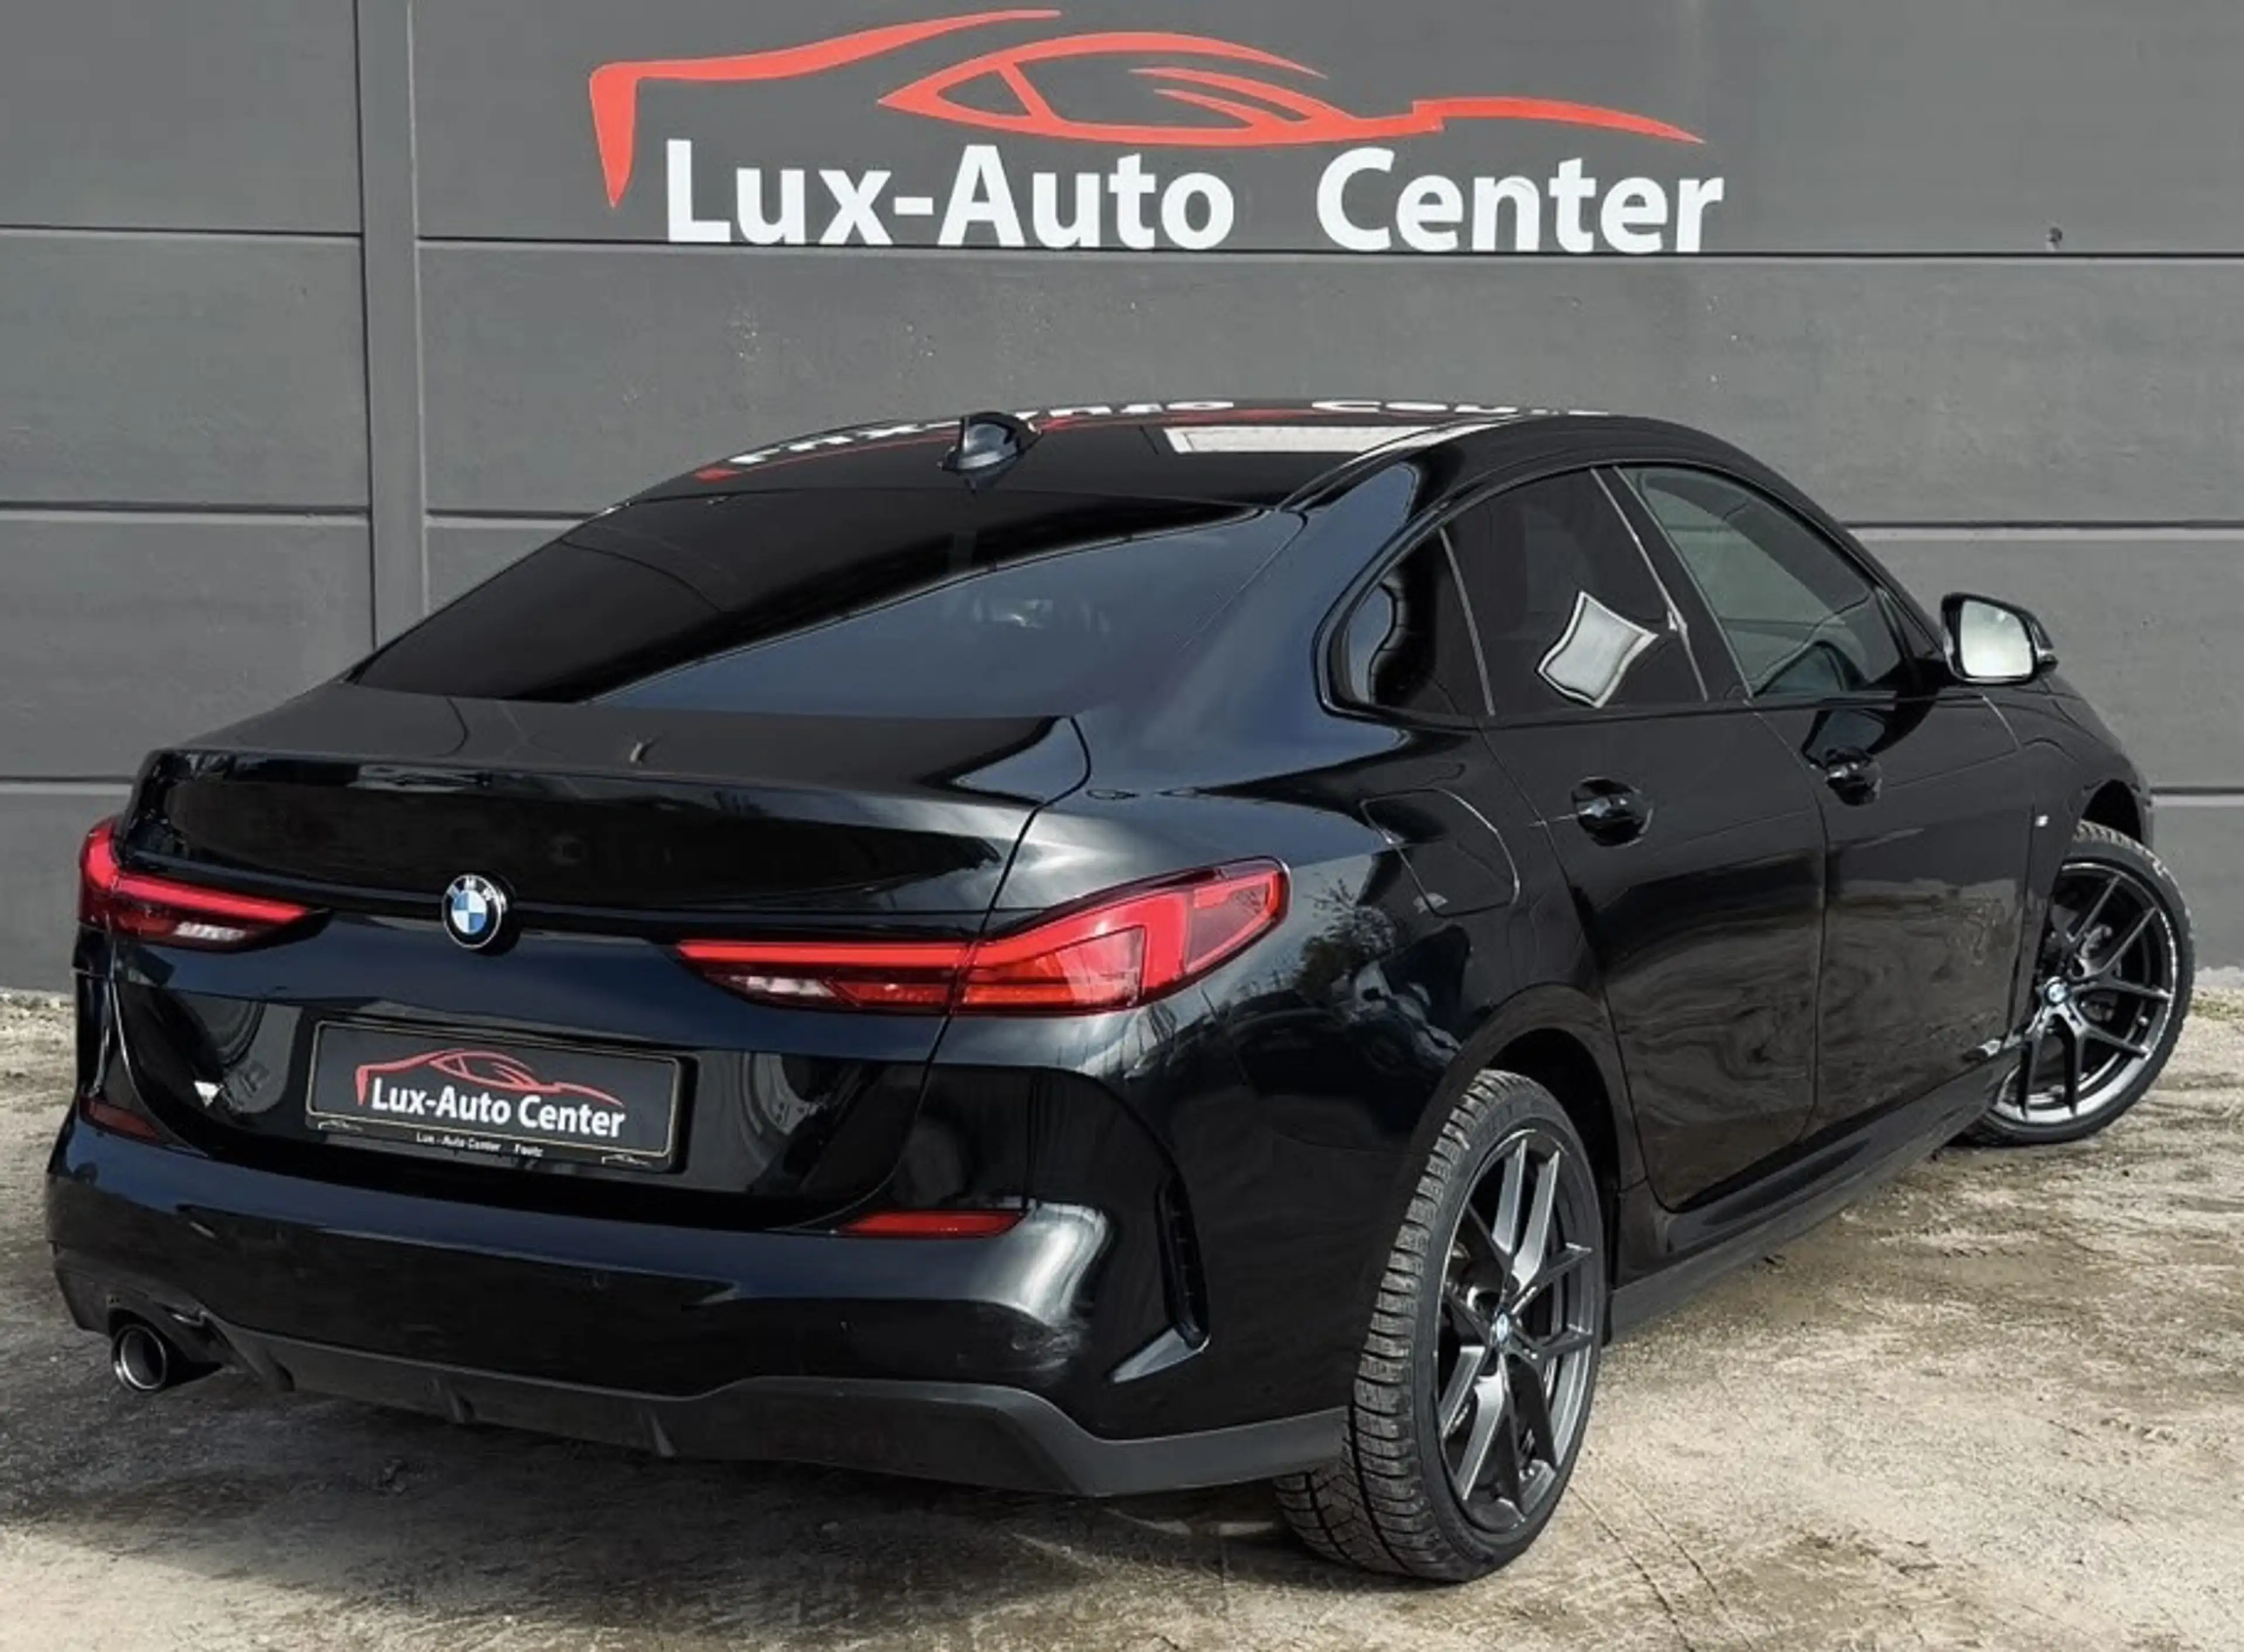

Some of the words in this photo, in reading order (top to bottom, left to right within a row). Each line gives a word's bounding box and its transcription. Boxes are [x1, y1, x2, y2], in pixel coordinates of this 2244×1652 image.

[666, 138, 1235, 250] Lux-Auto
[1316, 146, 1724, 254] Center
[370, 1077, 512, 1125] Lux-Auto
[517, 1095, 626, 1138] Center
